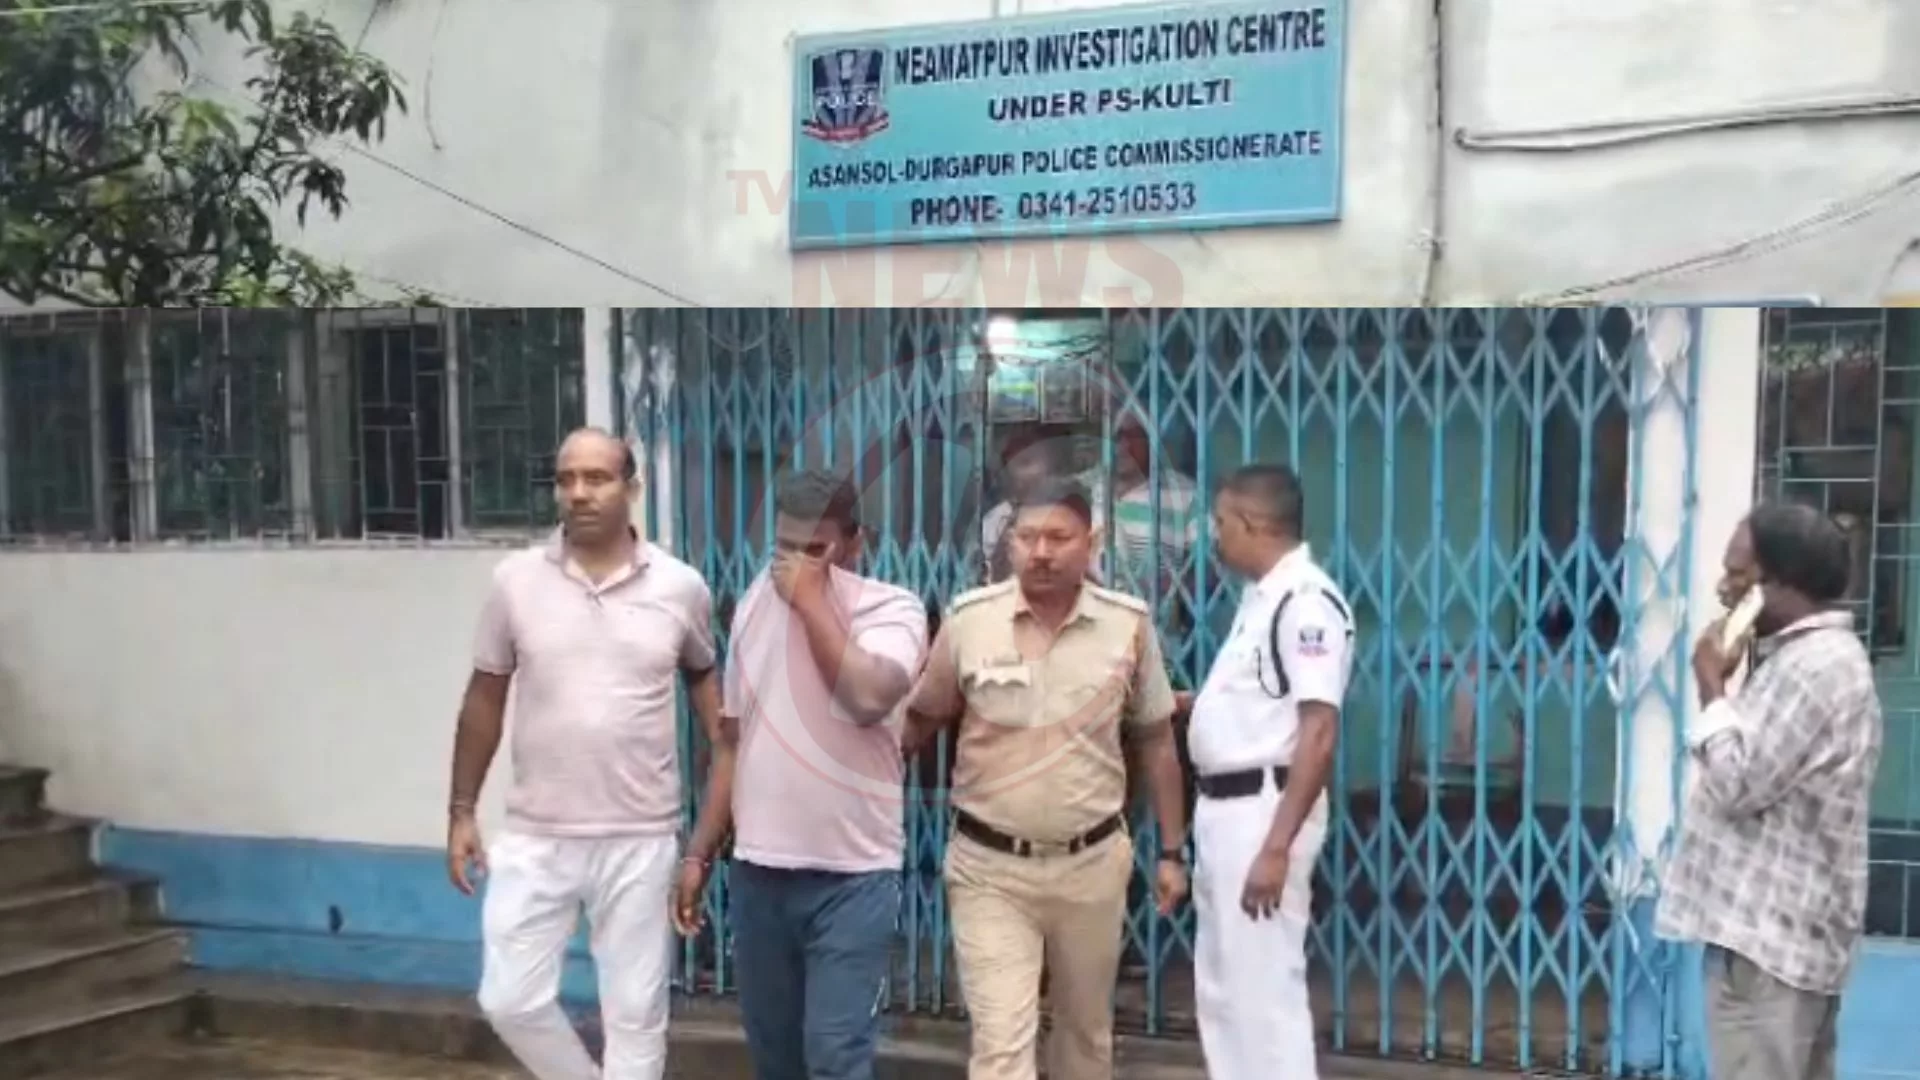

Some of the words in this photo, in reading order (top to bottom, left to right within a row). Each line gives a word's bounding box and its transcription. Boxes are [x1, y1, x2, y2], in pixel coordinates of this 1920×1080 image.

[895, 38, 1029, 84] NEAMATPUR
[1036, 18, 1218, 74] INVESTIGATION
[1226, 8, 1325, 53] CENTRE
[988, 90, 1085, 120] UNDER
[1098, 79, 1232, 113] PS-KULTI
[808, 153, 1015, 188] ASANSOL-DURGAPUR
[1023, 145, 1097, 174] POLICE
[1105, 131, 1322, 168] COMMISSIONERATE
[1018, 182, 1196, 219] 0341-2510533
